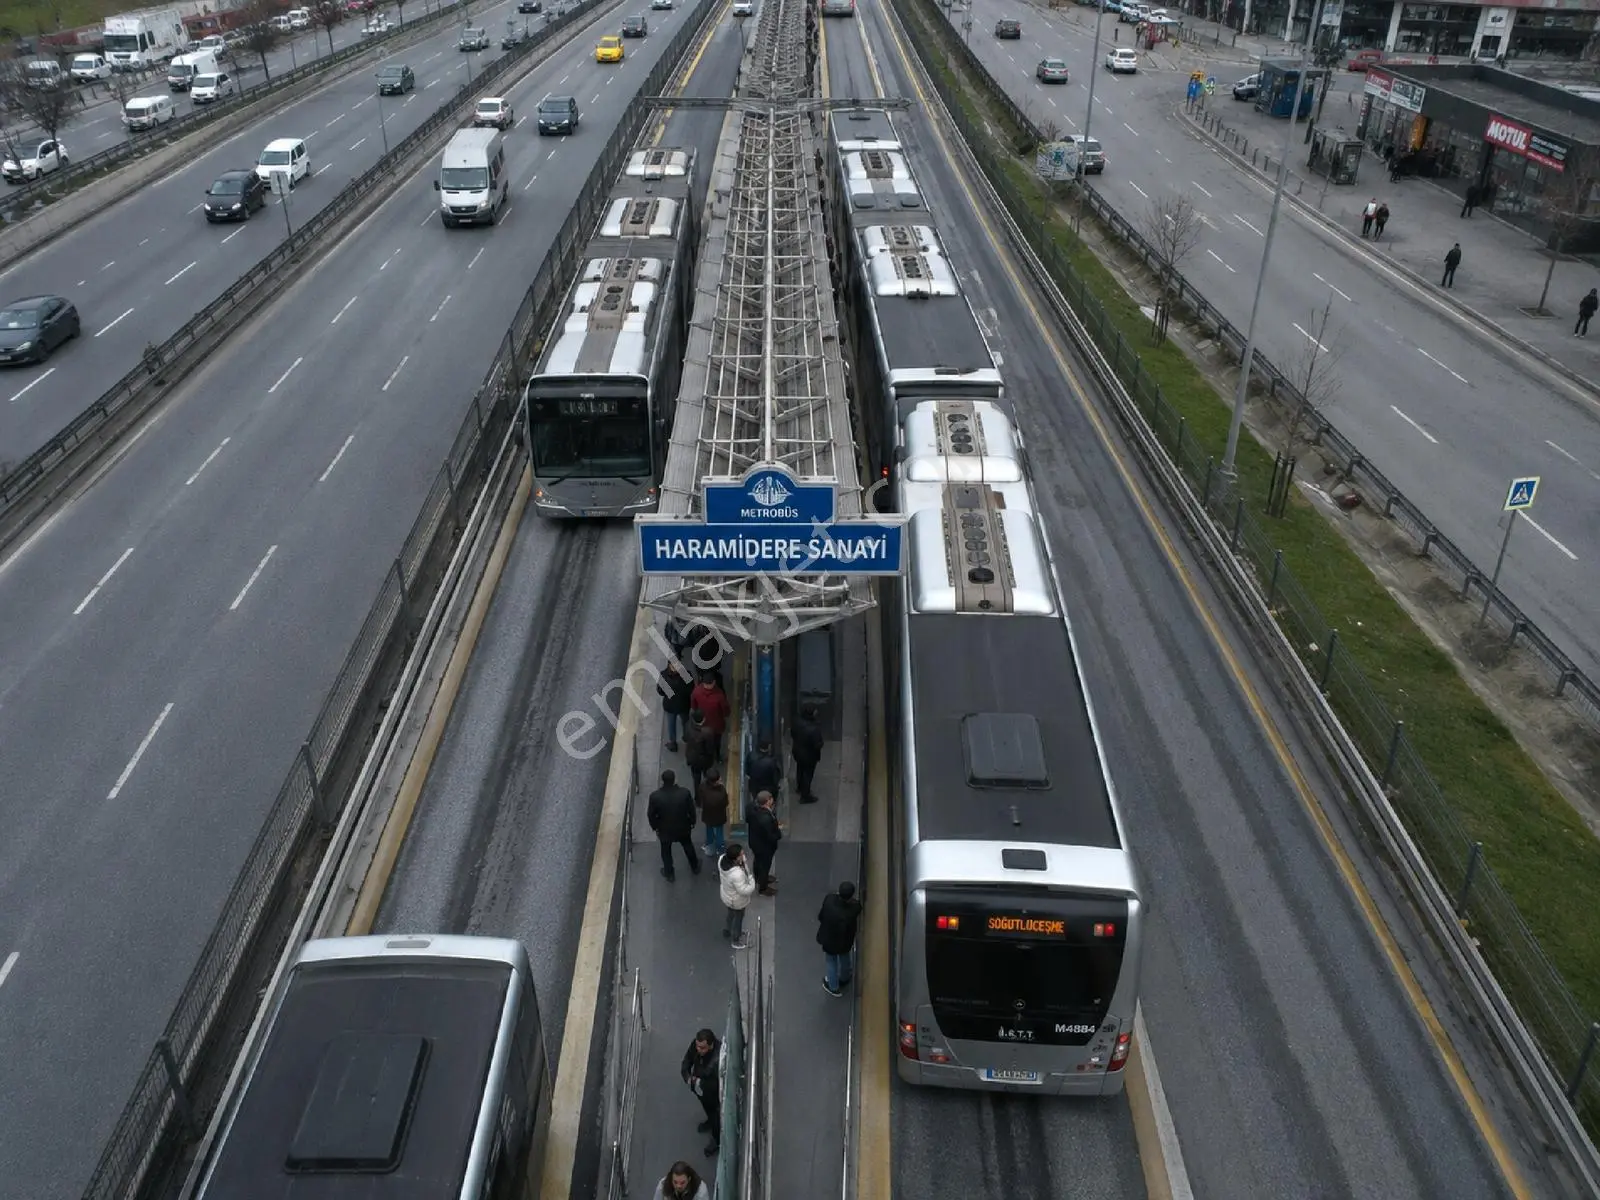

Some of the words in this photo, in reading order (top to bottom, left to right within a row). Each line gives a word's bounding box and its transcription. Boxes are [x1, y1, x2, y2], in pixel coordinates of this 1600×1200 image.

[1487, 120, 1527, 150] MOTUL
[740, 507, 799, 518] METROBÜS
[655, 534, 801, 560] HARAMİDERE
[807, 534, 887, 560] SANAYİ
[1055, 1023, 1095, 1033] M4884
